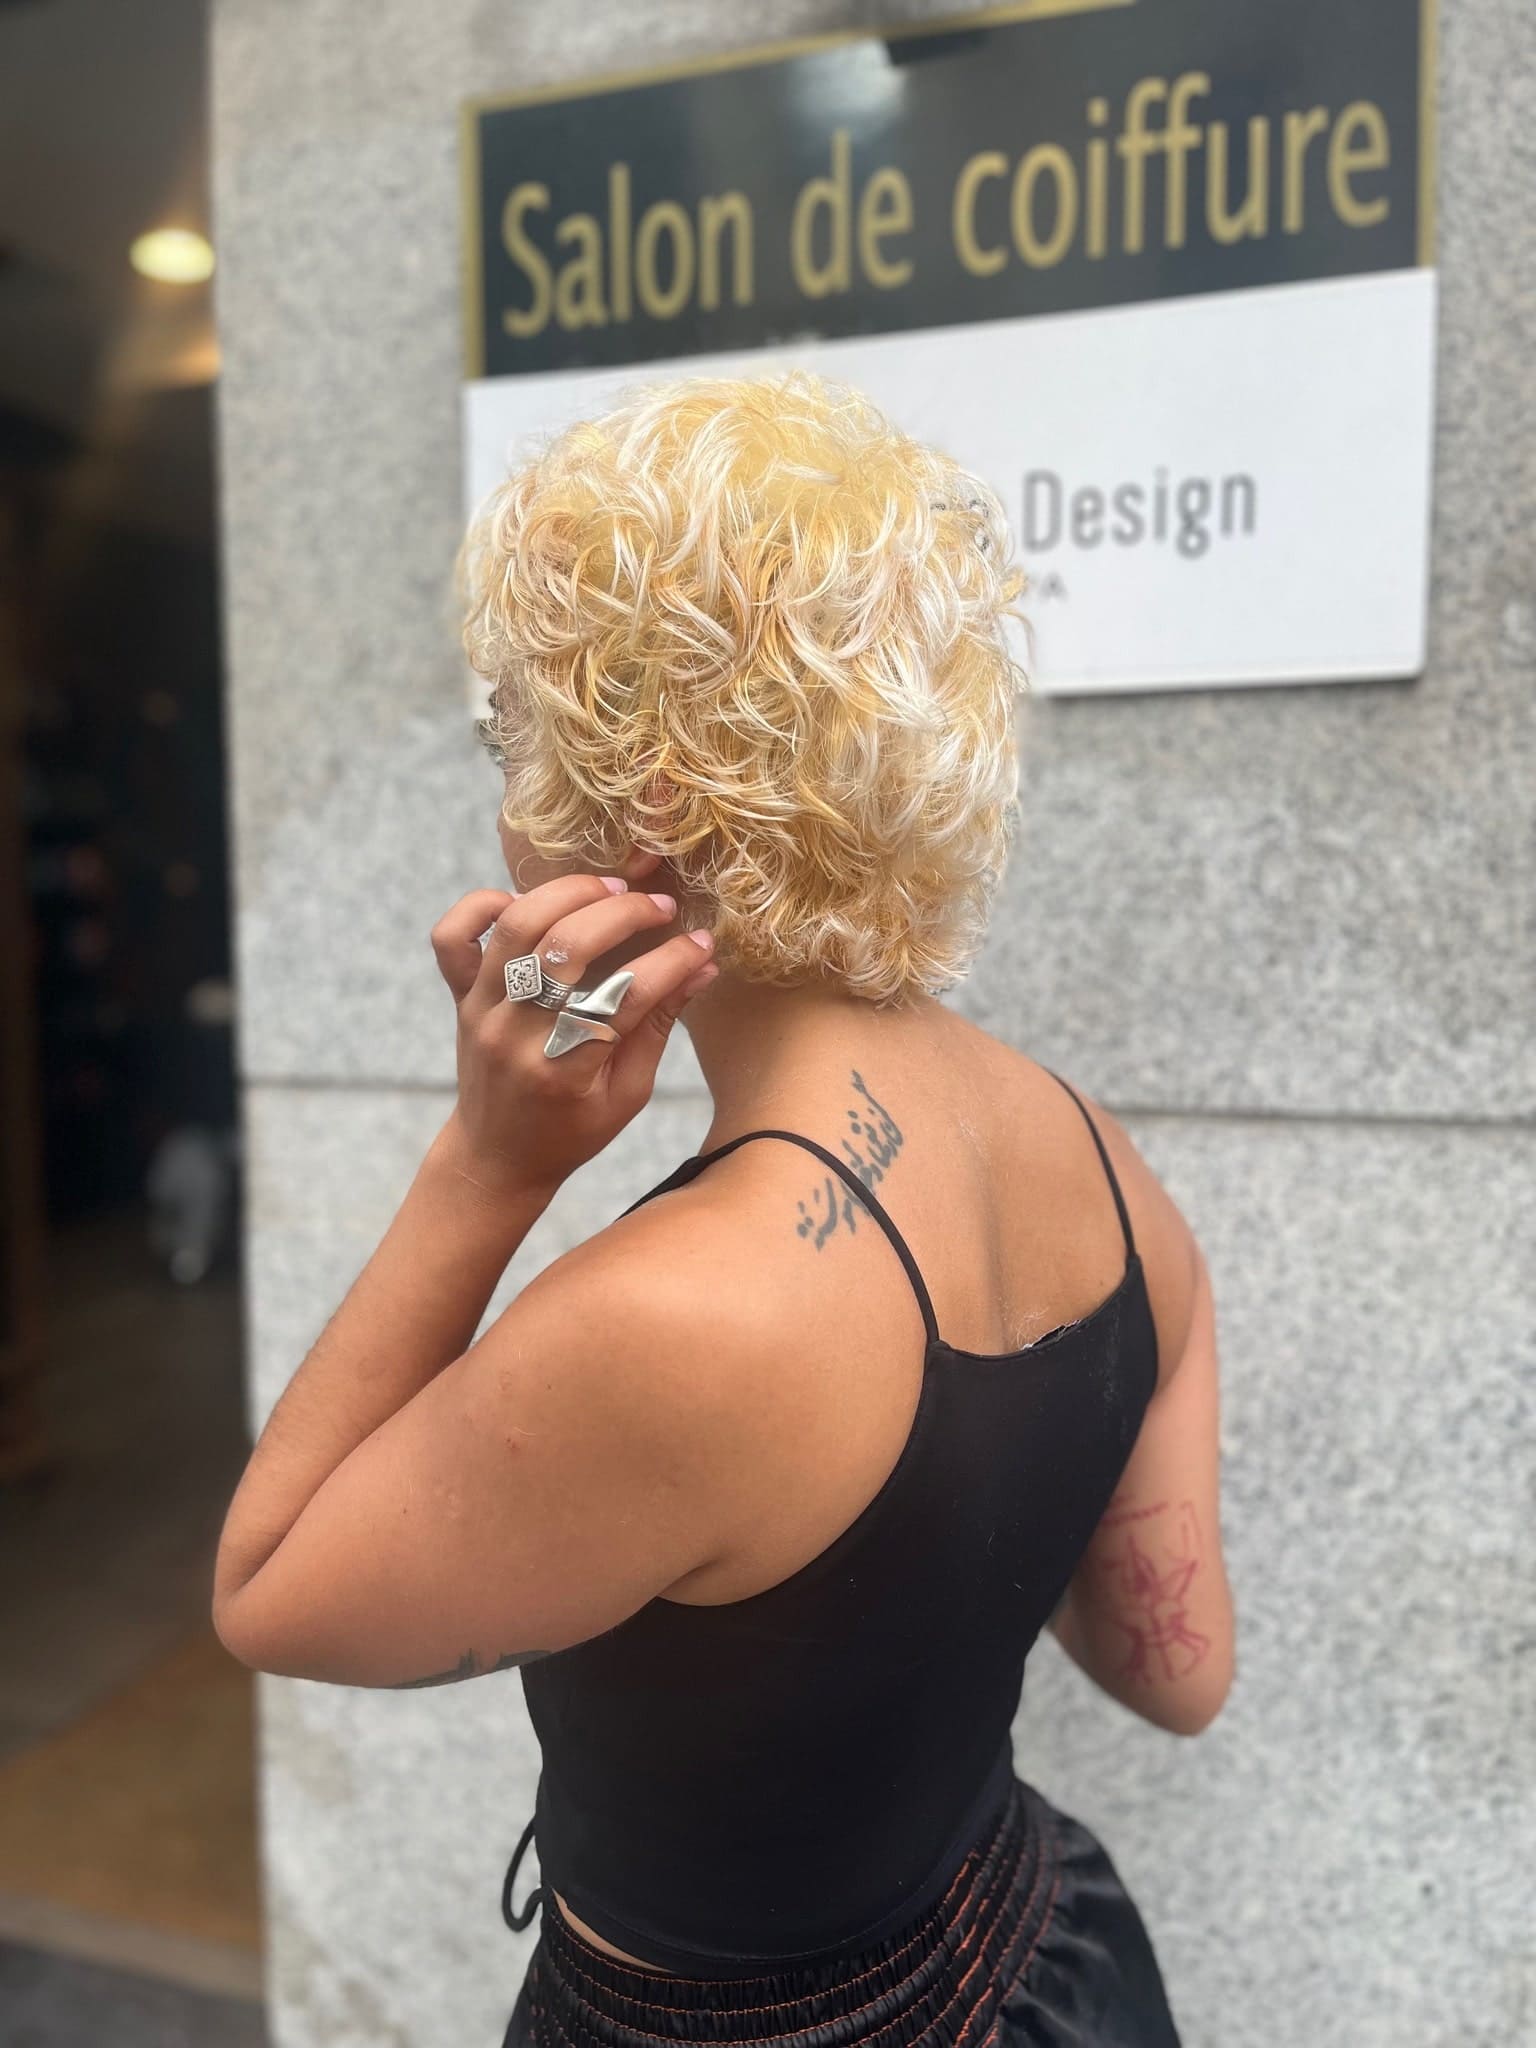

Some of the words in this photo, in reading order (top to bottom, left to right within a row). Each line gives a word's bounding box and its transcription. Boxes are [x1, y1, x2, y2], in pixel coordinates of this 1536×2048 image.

[502, 163, 754, 338] Salon
[792, 129, 914, 299] de
[952, 72, 1391, 277] coiffure
[1022, 465, 1257, 560] Design
